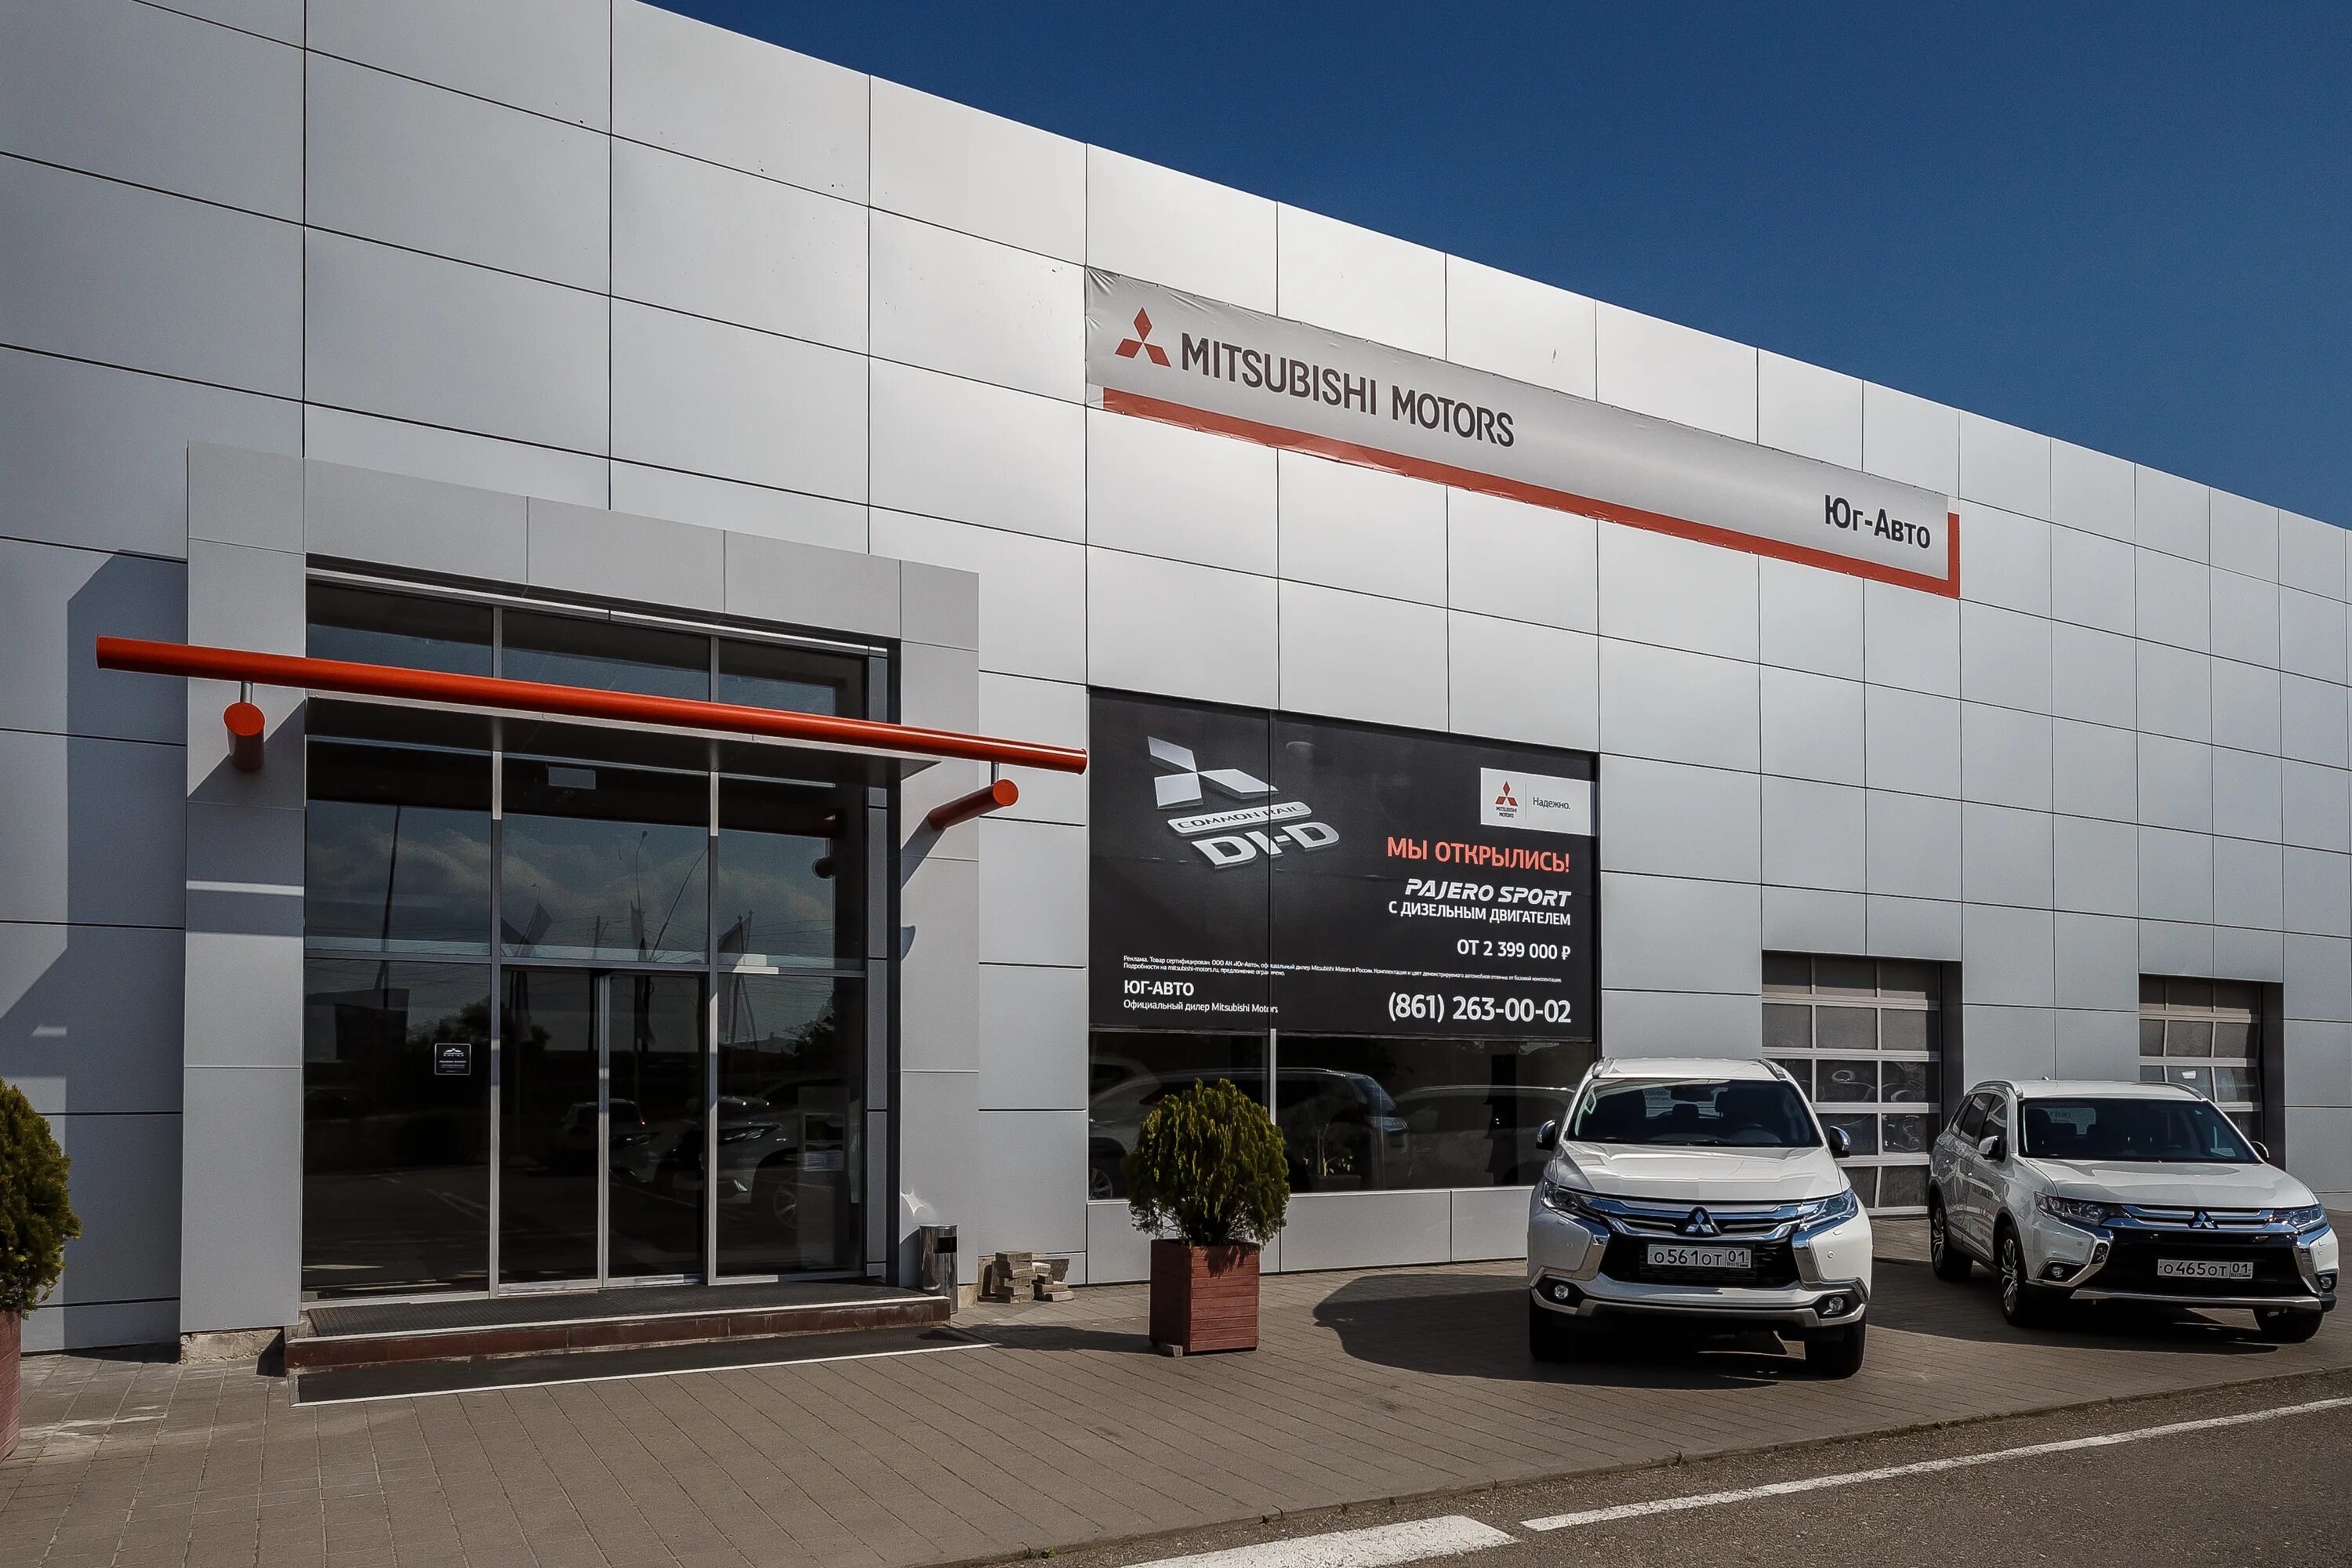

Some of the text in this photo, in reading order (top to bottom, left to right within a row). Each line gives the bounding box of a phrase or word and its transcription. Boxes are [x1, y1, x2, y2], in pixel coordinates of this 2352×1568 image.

[1181, 332, 1514, 447] MITSUBISHI MOTORS
[1825, 495, 1930, 548] Юг-Авто
[1533, 797, 1570, 809] Надежно.
[1178, 806, 1305, 828] COMMON RAIL
[1192, 822, 1339, 867] DI-D
[1387, 837, 1570, 873] МЫ ОТКРЫЛИСЬ!
[1405, 878, 1572, 907] PAJERO SPORT
[1388, 901, 1571, 926] С ДИЗЕЛЬНЫМ ДВИГАТЕЛЕМ
[1457, 939, 1479, 956] ОТ
[1483, 941, 1493, 956] 2
[1497, 942, 1525, 957] 399
[1529, 943, 1557, 960] 000
[1123, 980, 1195, 996] ЮГ-АВТО
[1123, 999, 1279, 1013] Официальный дилер Mitsubishi Motors
[1388, 992, 1572, 1023] (861) 263-00-02
